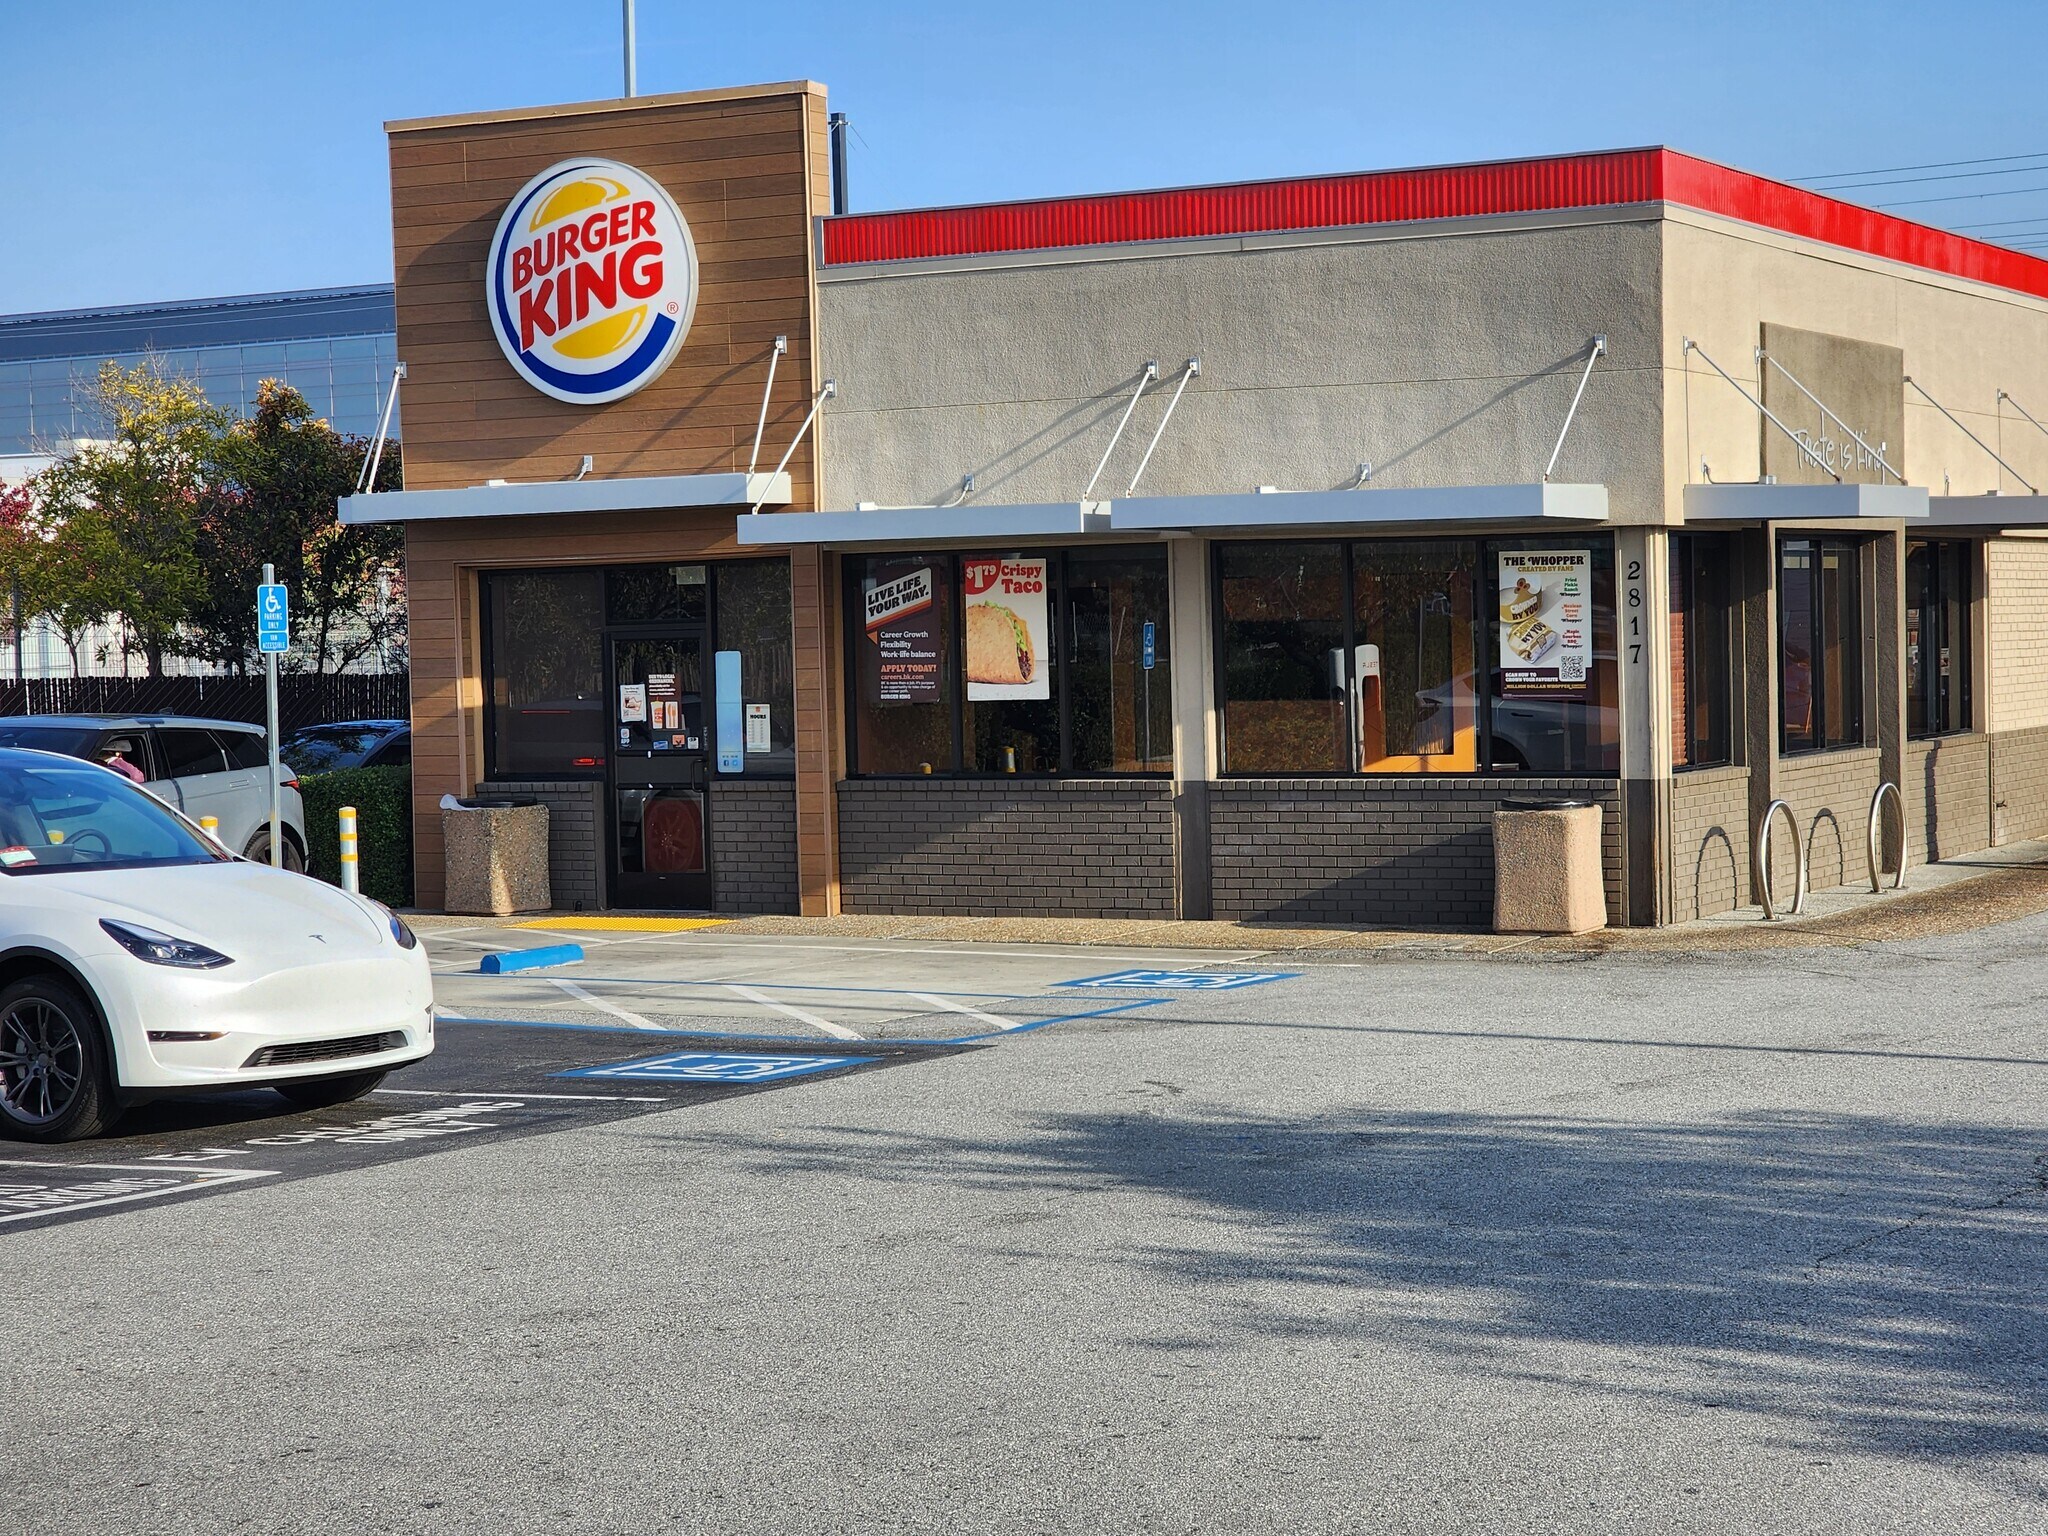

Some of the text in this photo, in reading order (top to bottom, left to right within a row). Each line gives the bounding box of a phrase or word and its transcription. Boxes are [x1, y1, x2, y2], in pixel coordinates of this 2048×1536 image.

[512, 200, 656, 294] BURGER
[519, 240, 664, 352] KING
[1792, 410, 1835, 473] Taste
[1838, 427, 1853, 471] is
[1000, 564, 1042, 578] Crispy
[1504, 555, 1584, 566] THE WHOPPER
[868, 576, 921, 606] LIVE LIFE
[1001, 578, 1042, 594] Taco
[868, 584, 929, 617] YOUR WAY.
[1512, 612, 1523, 620] BY
[1524, 603, 1538, 616] YOU
[1627, 560, 1642, 664] 2817
[264, 612, 282, 620] PARKING
[880, 640, 912, 650] Flexibility
[906, 664, 936, 672] TODAY!
[140, 1101, 525, 1161] EV CHARGING
[335, 1120, 500, 1144] ONLY
[0, 1177, 182, 1213] ARKING
